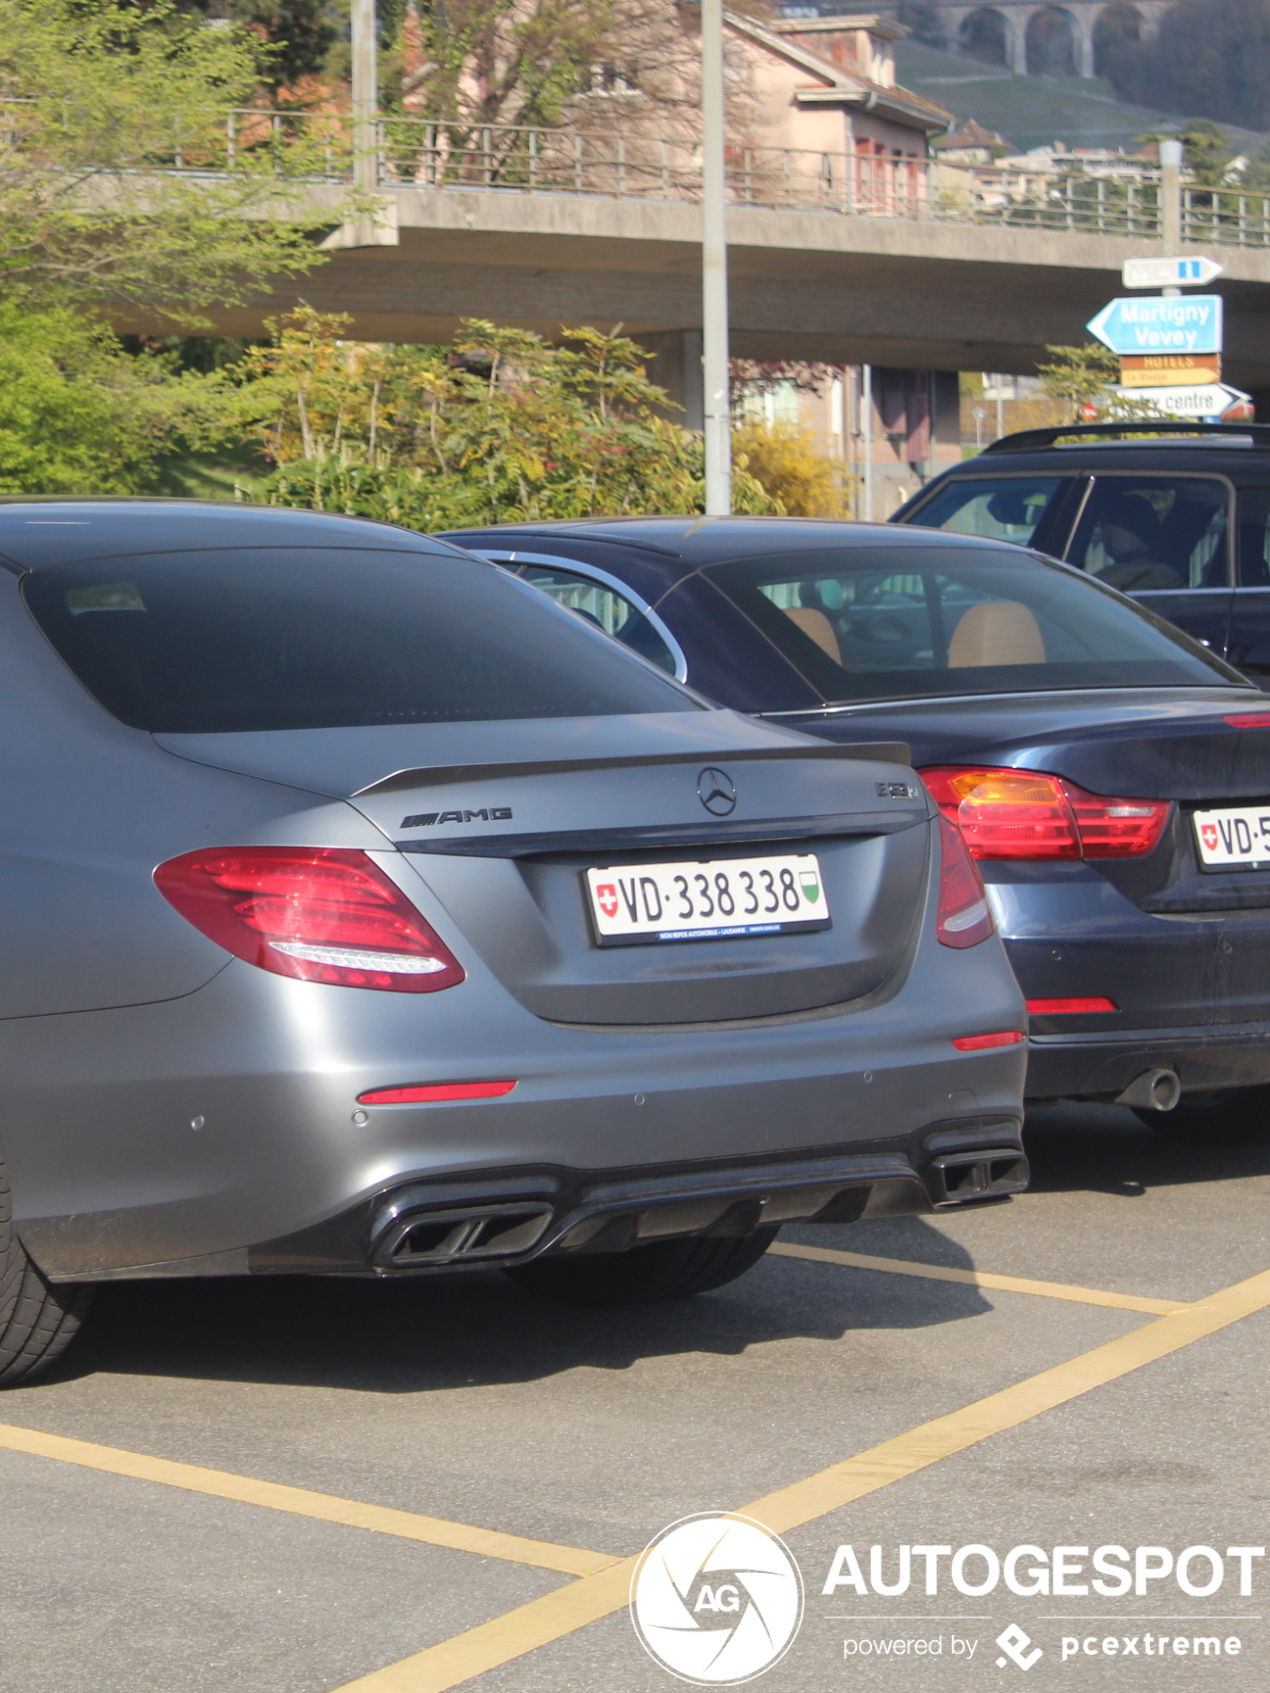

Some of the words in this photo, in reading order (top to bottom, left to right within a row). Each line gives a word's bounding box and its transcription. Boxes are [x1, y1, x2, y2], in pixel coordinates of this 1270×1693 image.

[1120, 303, 1211, 327] Martigny
[1133, 326, 1199, 349] Vevey
[1143, 355, 1195, 369] HOTELS
[1165, 390, 1214, 410] centre
[673, 930, 688, 939] REPOS
[721, 927, 746, 935] LAUSANNE
